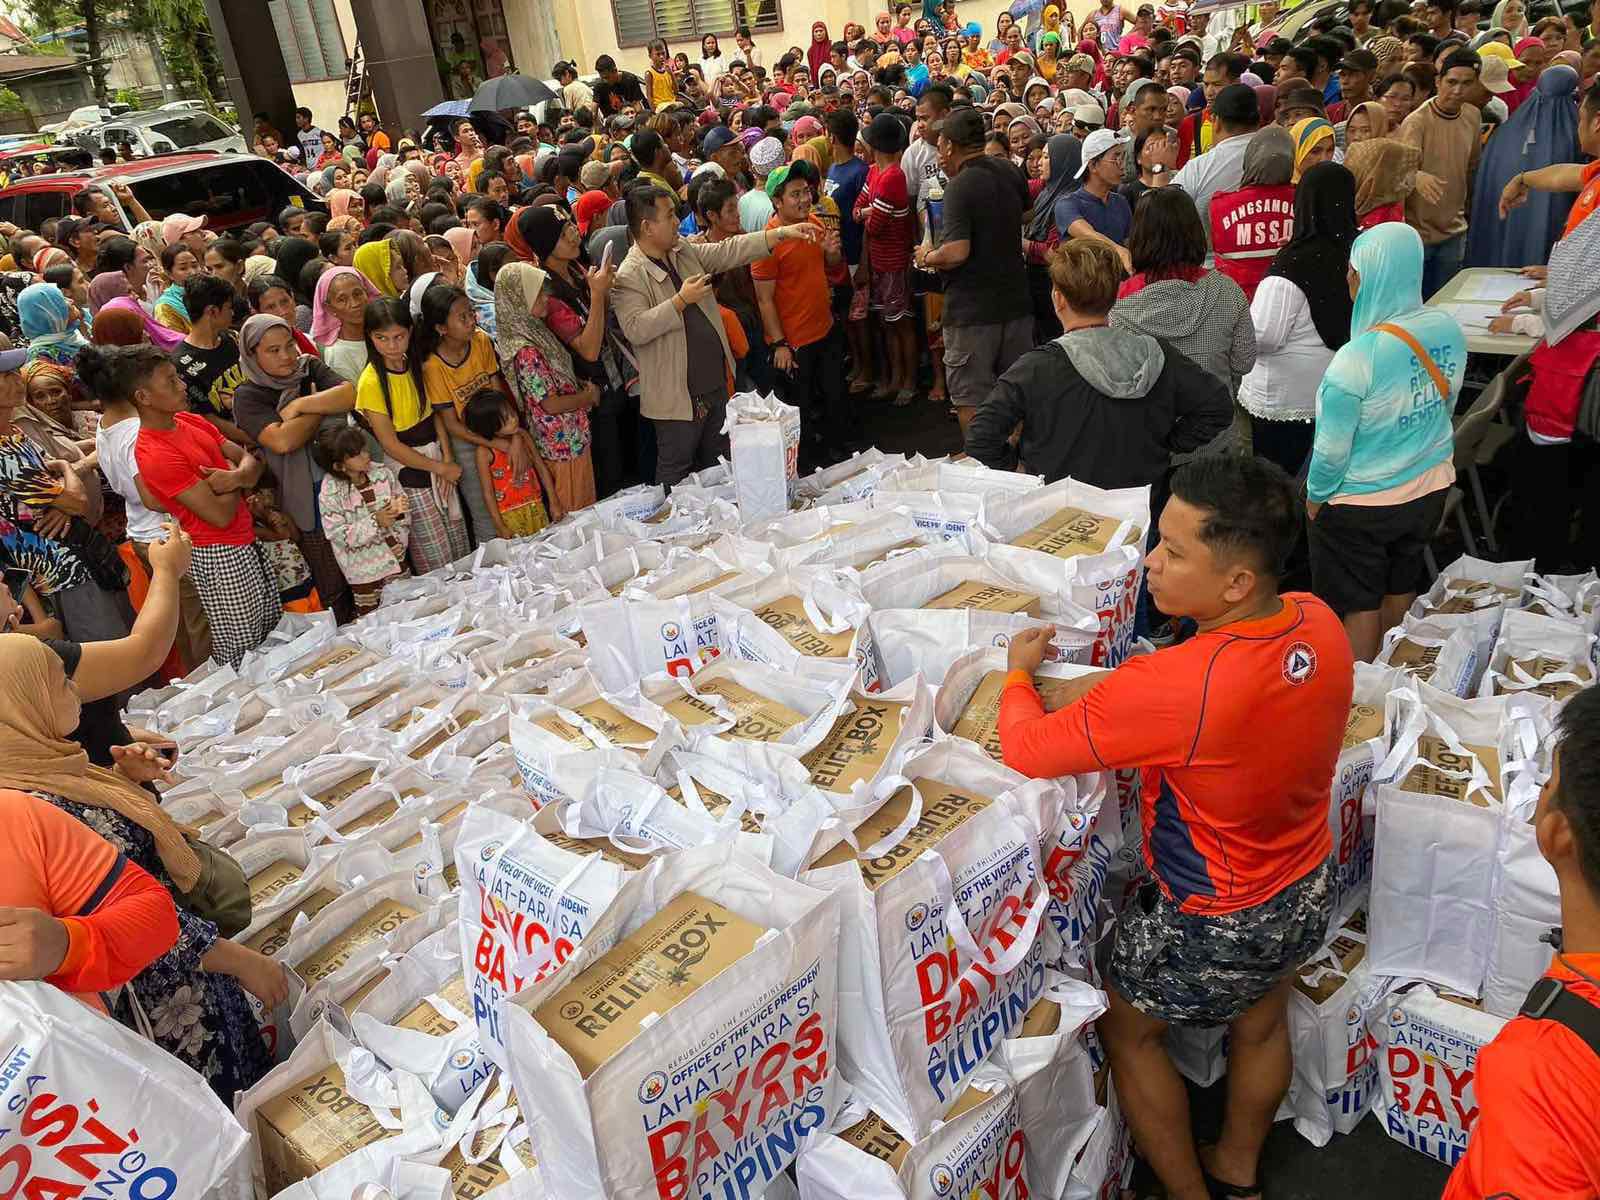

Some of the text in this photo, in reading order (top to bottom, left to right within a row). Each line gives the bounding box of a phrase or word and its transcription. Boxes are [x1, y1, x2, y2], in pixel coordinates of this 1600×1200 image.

[811, 742, 858, 787] ELIEF
[845, 706, 888, 740] BOX
[959, 885, 973, 902] OF
[972, 874, 993, 893] THE
[990, 861, 1012, 882] VICE
[560, 914, 583, 940] SA
[661, 912, 728, 964] BOX
[590, 974, 618, 1000] OFFICE
[660, 908, 699, 941] PRESIDENT
[671, 960, 822, 1087] OFFICE OF THE VICE PRESIDENT
[928, 962, 1045, 1104] PILIPINO
[1410, 1022, 1477, 1055] OFFICE OF TH
[642, 986, 821, 1131] LAHAT-PARA SA
[668, 1038, 707, 1070] REPUBLIC
[928, 1033, 952, 1066] AT
[7, 1075, 49, 1115] SA
[303, 1076, 355, 1114] BOX
[1392, 1078, 1480, 1132] BAY
[955, 1148, 983, 1179] OFFICE
[981, 1133, 993, 1150] OF
